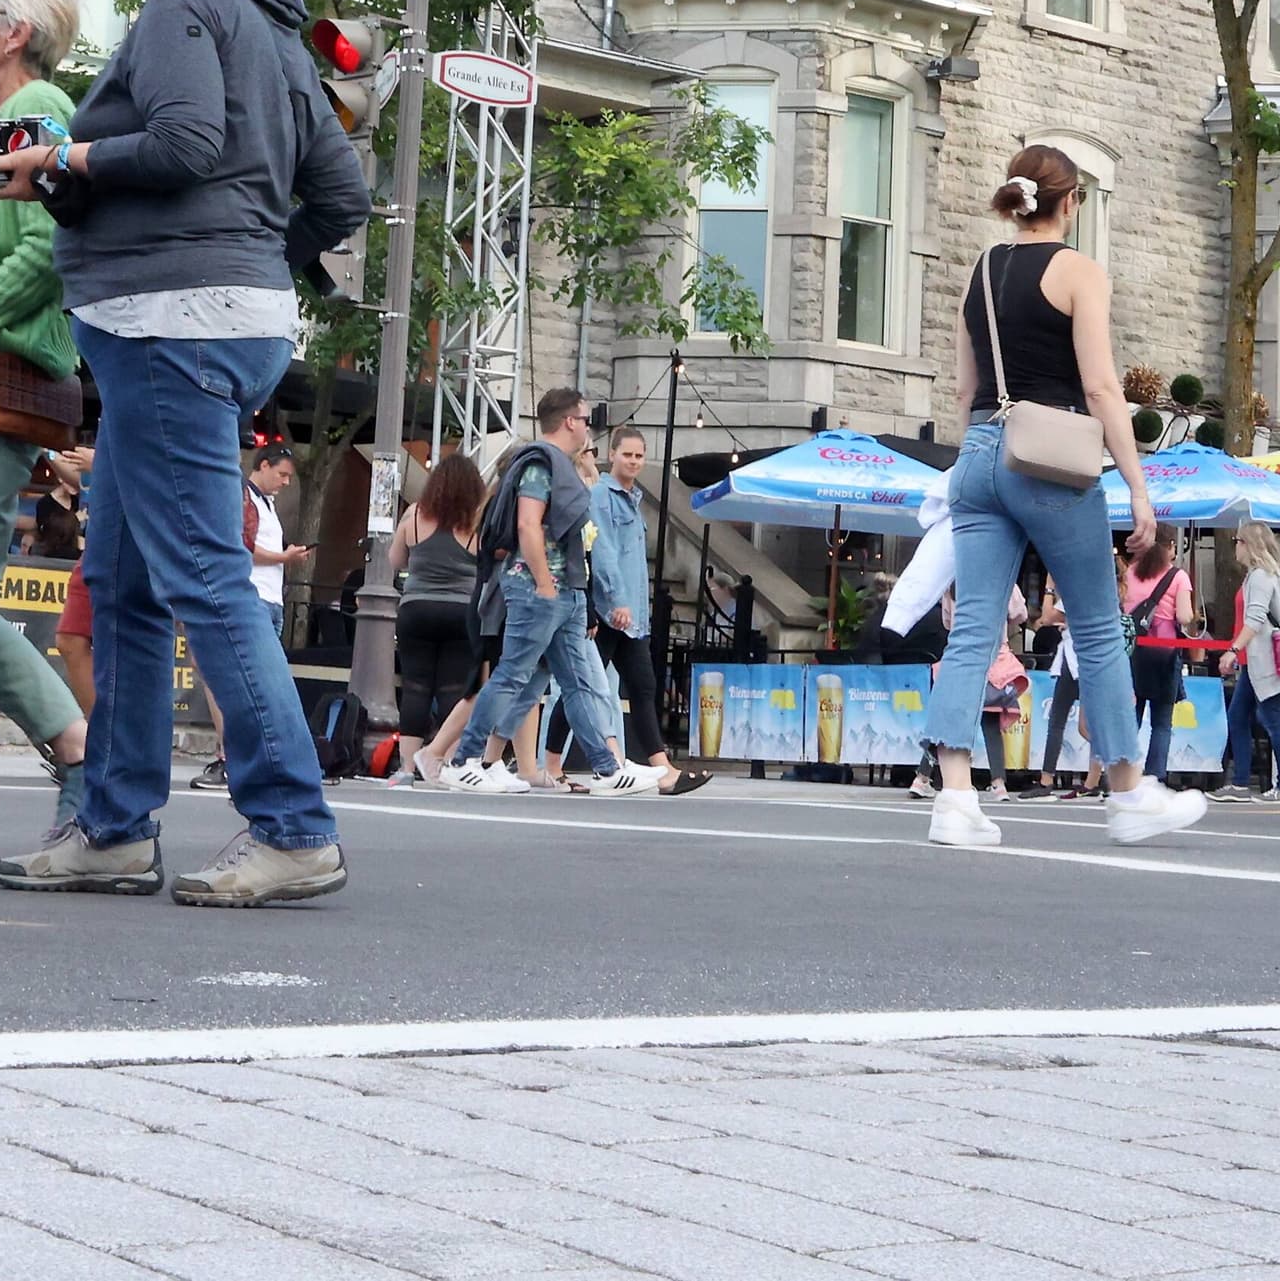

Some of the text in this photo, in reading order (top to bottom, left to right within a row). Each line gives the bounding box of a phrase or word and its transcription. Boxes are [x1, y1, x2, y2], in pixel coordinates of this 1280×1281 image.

[448, 66, 482, 84] Grande
[510, 80, 525, 93] Est
[817, 447, 897, 464] Coors
[816, 487, 853, 499] PRENDS
[871, 490, 907, 504] Chill
